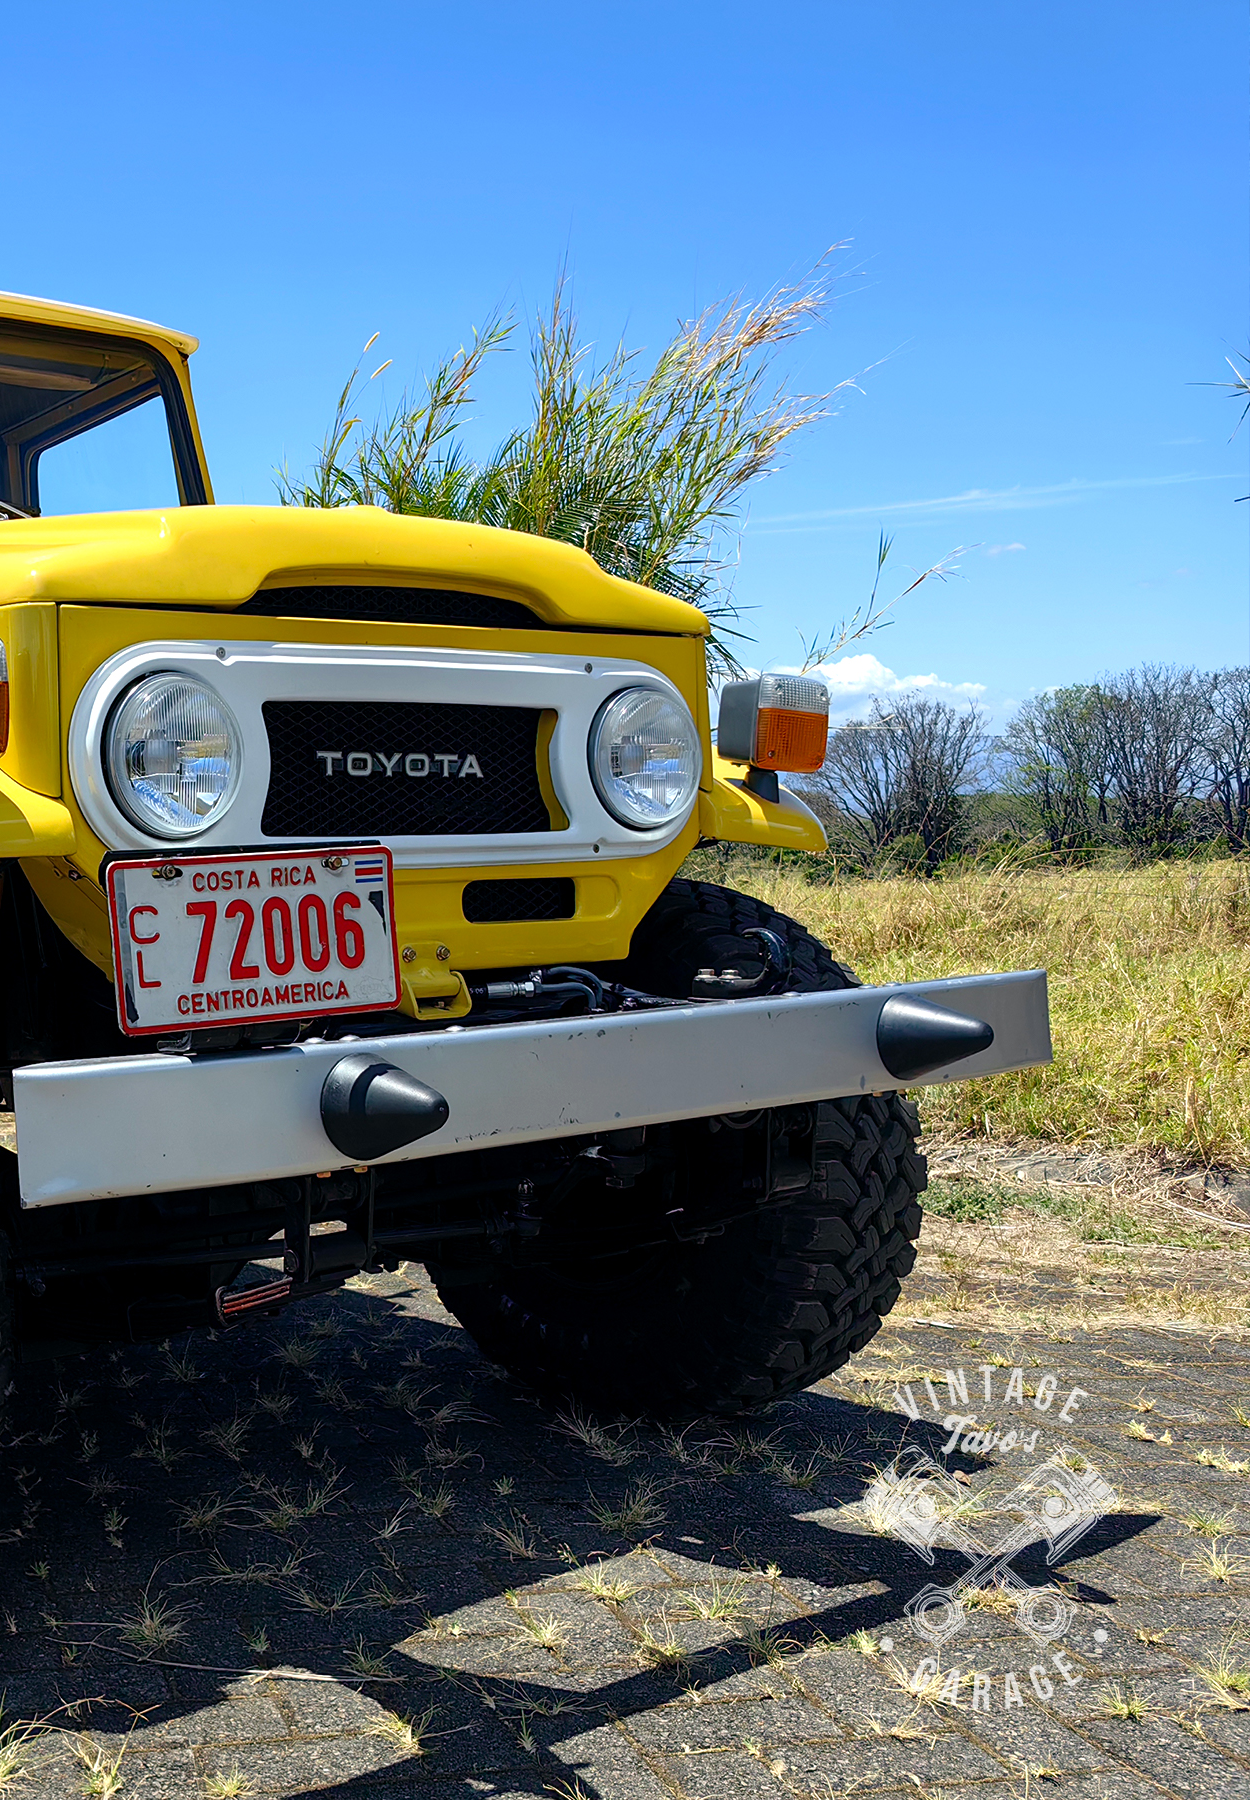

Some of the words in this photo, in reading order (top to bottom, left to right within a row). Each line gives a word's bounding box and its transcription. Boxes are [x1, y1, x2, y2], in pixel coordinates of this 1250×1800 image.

[316, 750, 484, 778] TOYOTA
[192, 869, 260, 892] COSTA
[270, 865, 317, 888] RICA
[186, 890, 366, 984] 72006
[177, 980, 350, 1015] CENTROAMERICA
